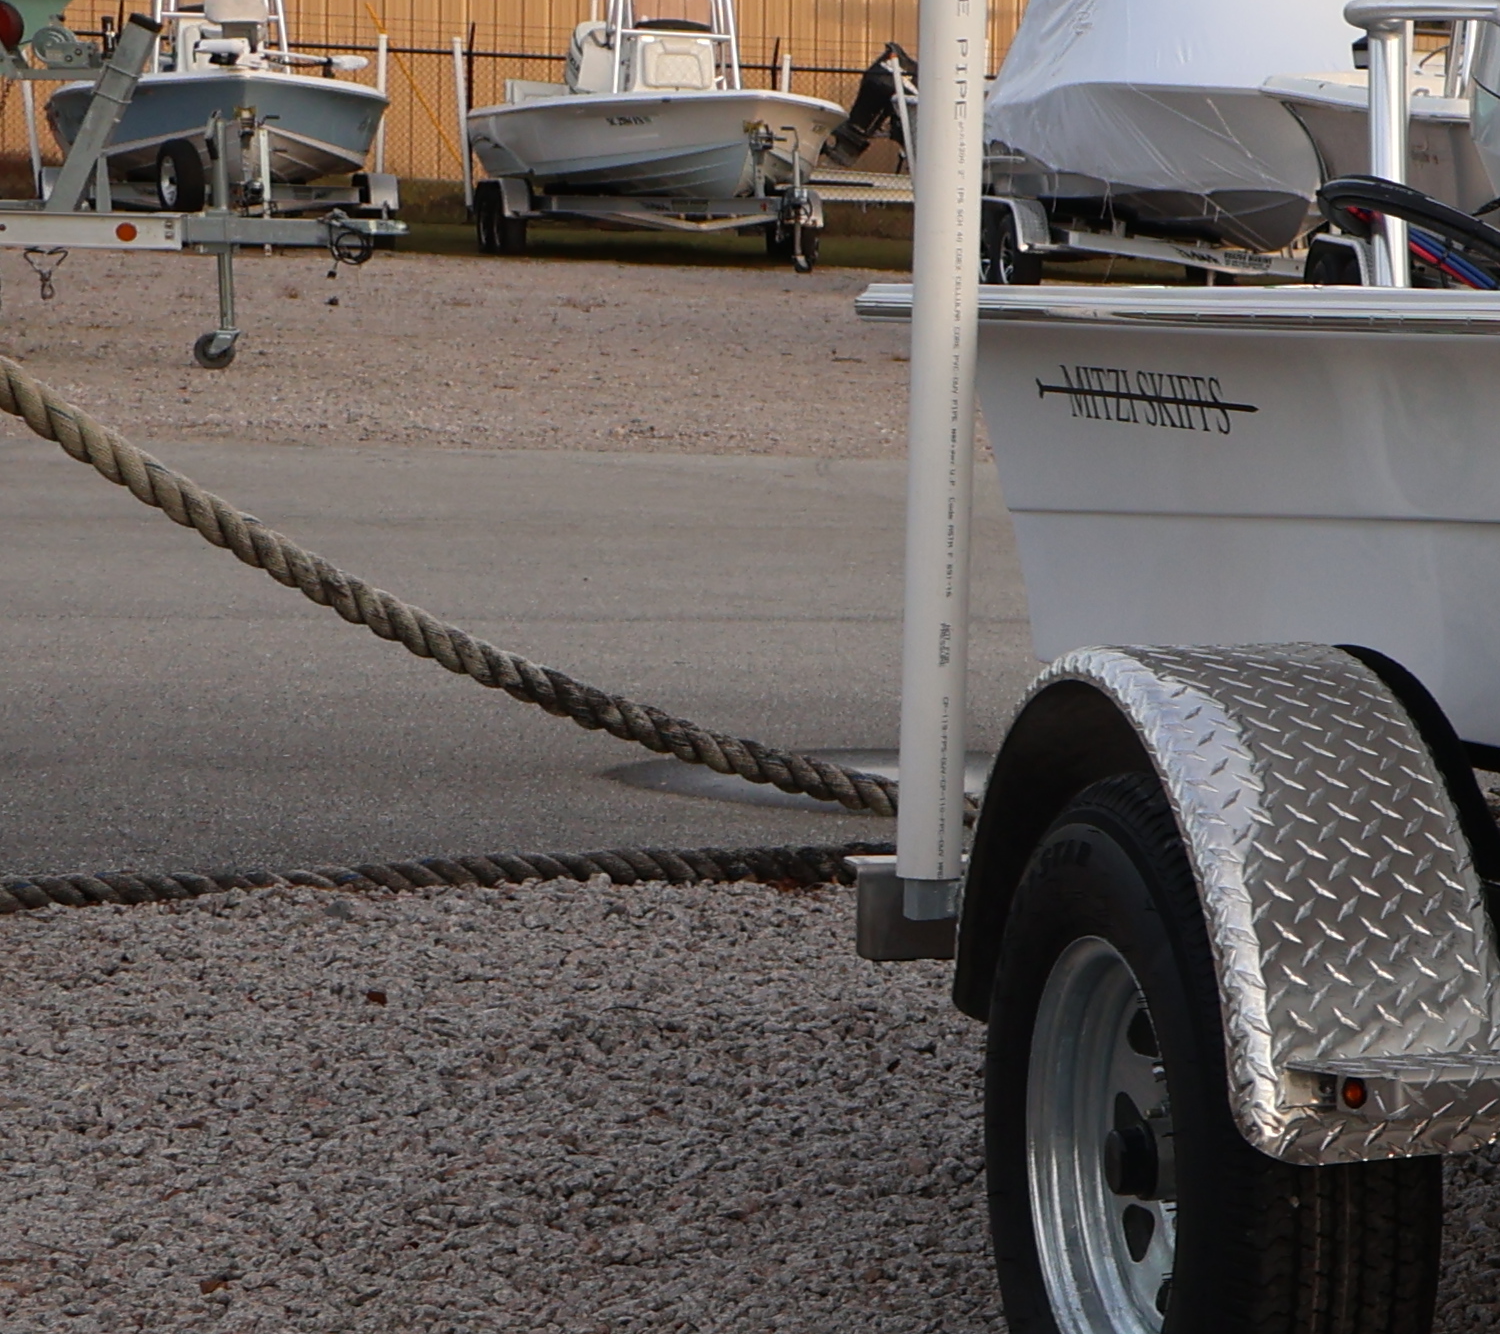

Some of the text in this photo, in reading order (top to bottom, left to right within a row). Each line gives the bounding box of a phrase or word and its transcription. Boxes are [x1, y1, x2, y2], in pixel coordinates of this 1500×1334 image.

[953, 38, 969, 121] PIPE
[1060, 365, 1231, 435] MITZI SKIFFS
